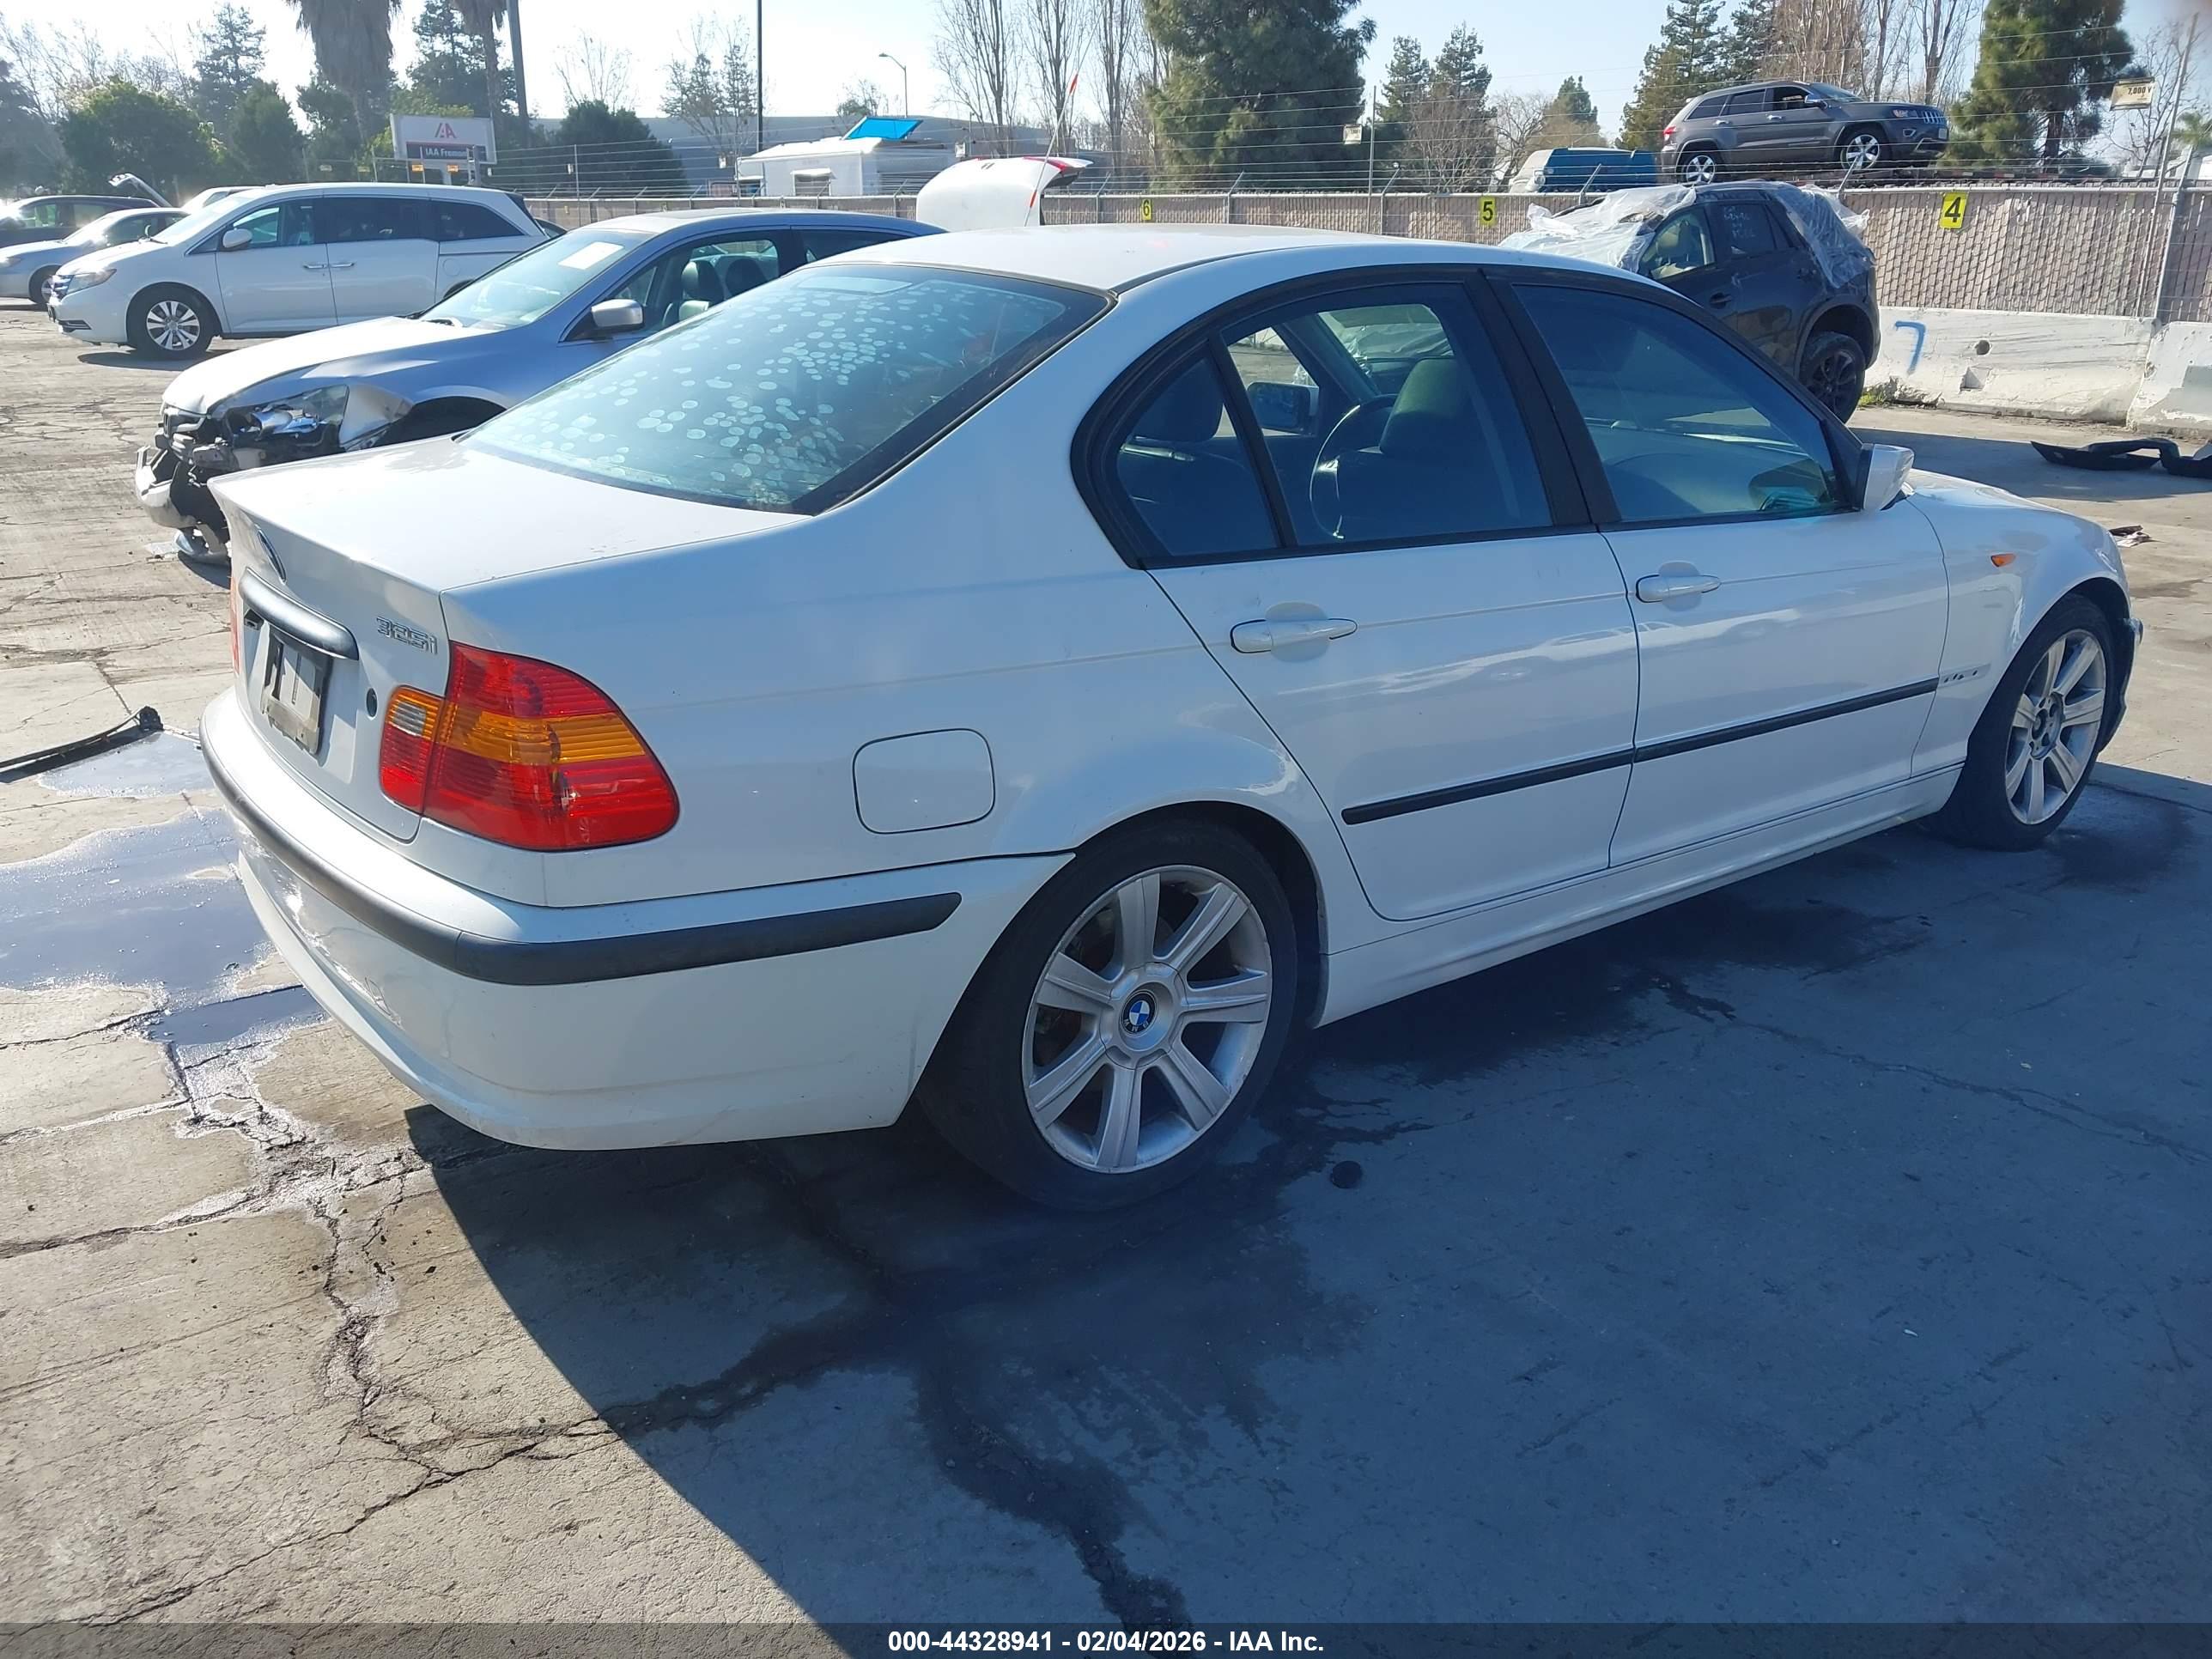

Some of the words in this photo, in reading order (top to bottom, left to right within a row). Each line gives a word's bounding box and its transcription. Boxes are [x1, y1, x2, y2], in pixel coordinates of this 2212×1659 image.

[2128, 87, 2147, 96] 7,000
[425, 147, 440, 155] IAA
[441, 148, 468, 157] Fremon
[1143, 199, 1150, 216] 6
[1483, 200, 1493, 222] 5
[1944, 197, 1961, 223] 4
[1894, 320, 1926, 375] 7
[376, 616, 438, 655] 325i
